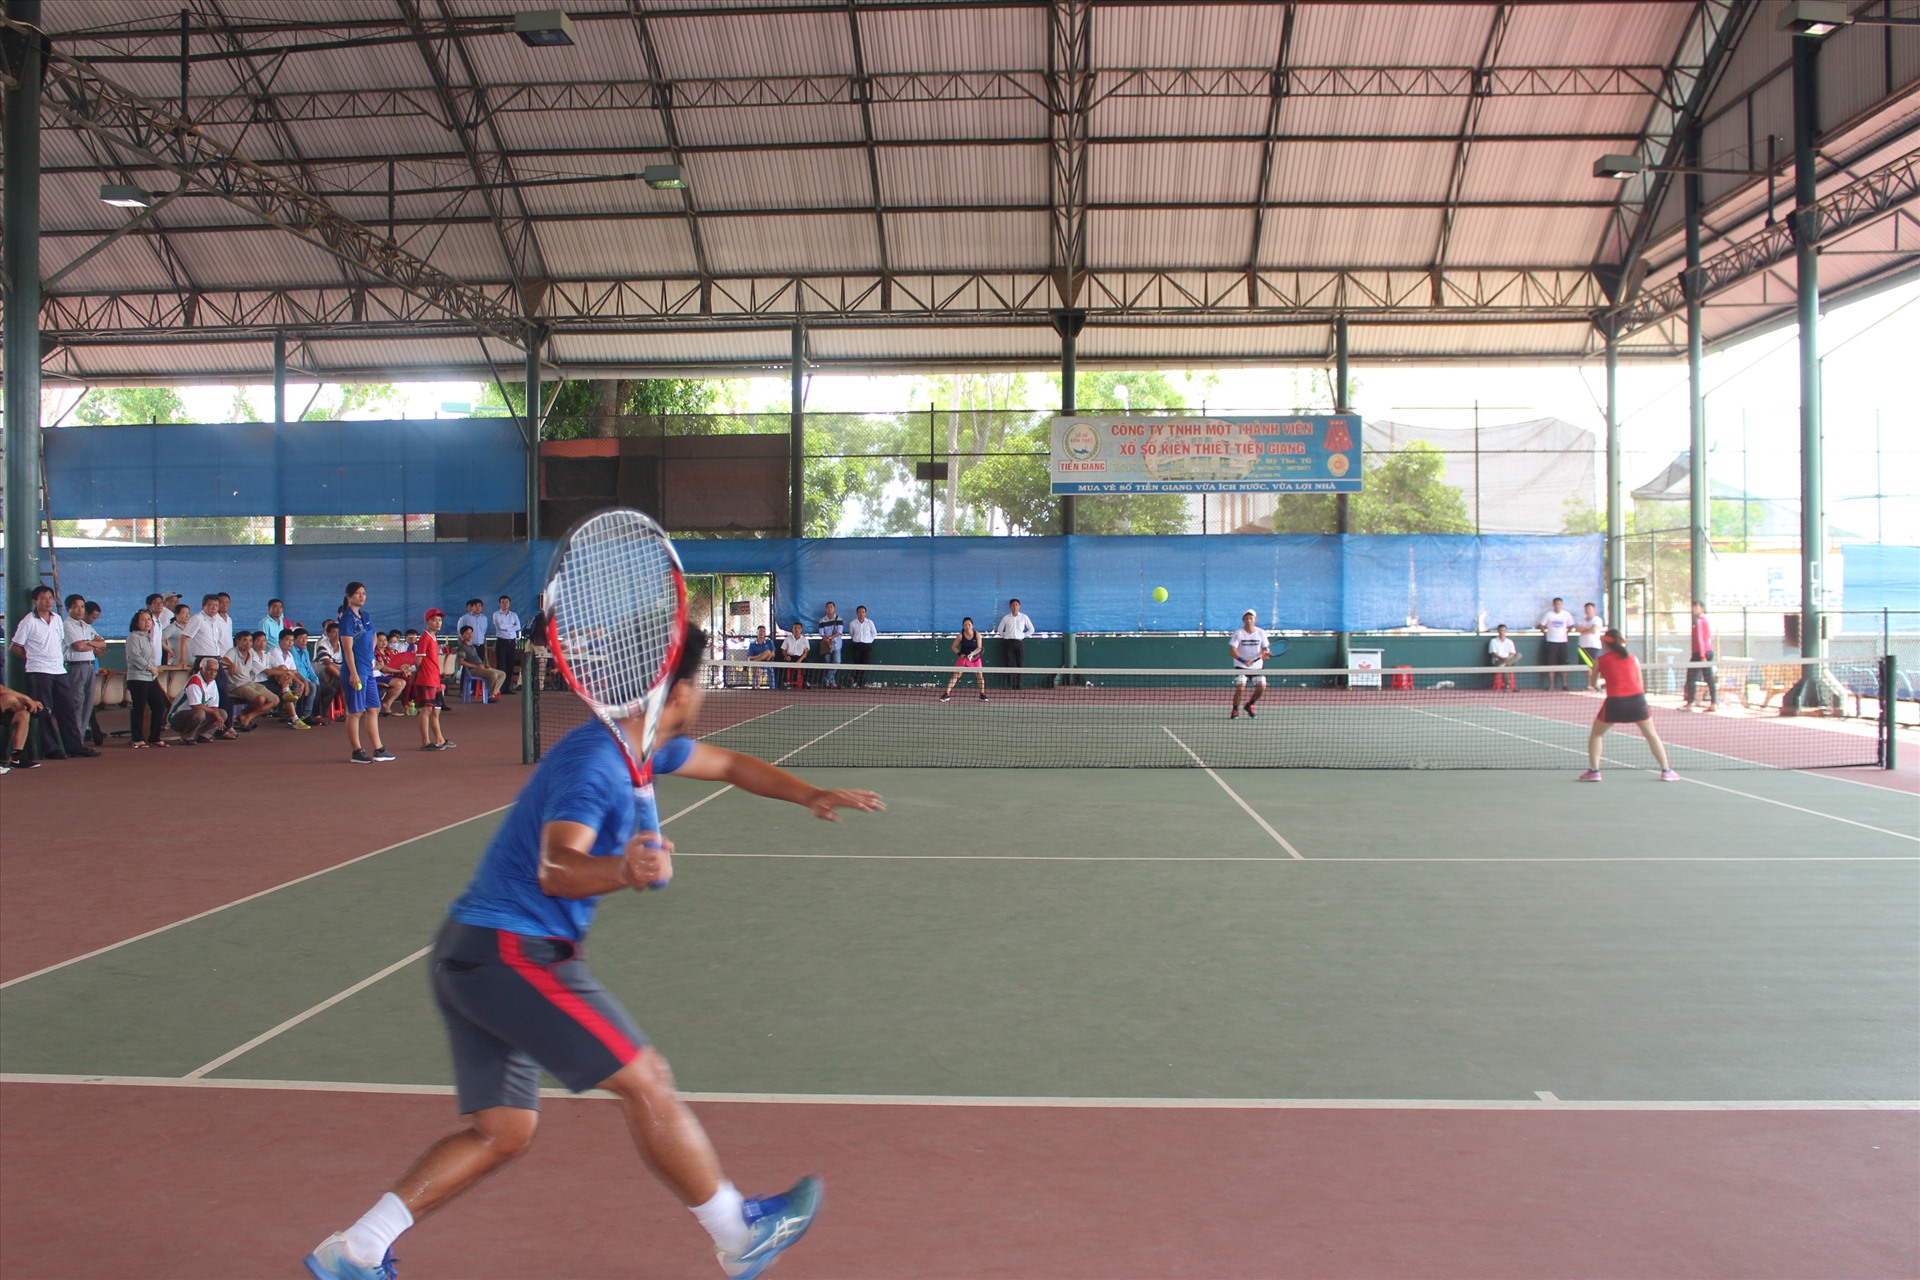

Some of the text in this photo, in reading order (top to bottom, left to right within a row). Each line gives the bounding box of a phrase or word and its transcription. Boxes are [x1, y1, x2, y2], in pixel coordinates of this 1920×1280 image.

[1111, 419, 1313, 437] CÔNG TY TNHH MỘT THÀNH VIÊN
[1119, 438, 1306, 455] XỔ SỐ KIẾN THIẾT TIỀN GIANG
[1081, 462, 1105, 471] GIANG
[1078, 484, 1100, 492] MUA
[1119, 482, 1133, 491] SỐ
[1218, 483, 1236, 491] ÍCH
[1315, 482, 1337, 490] NHÀ
